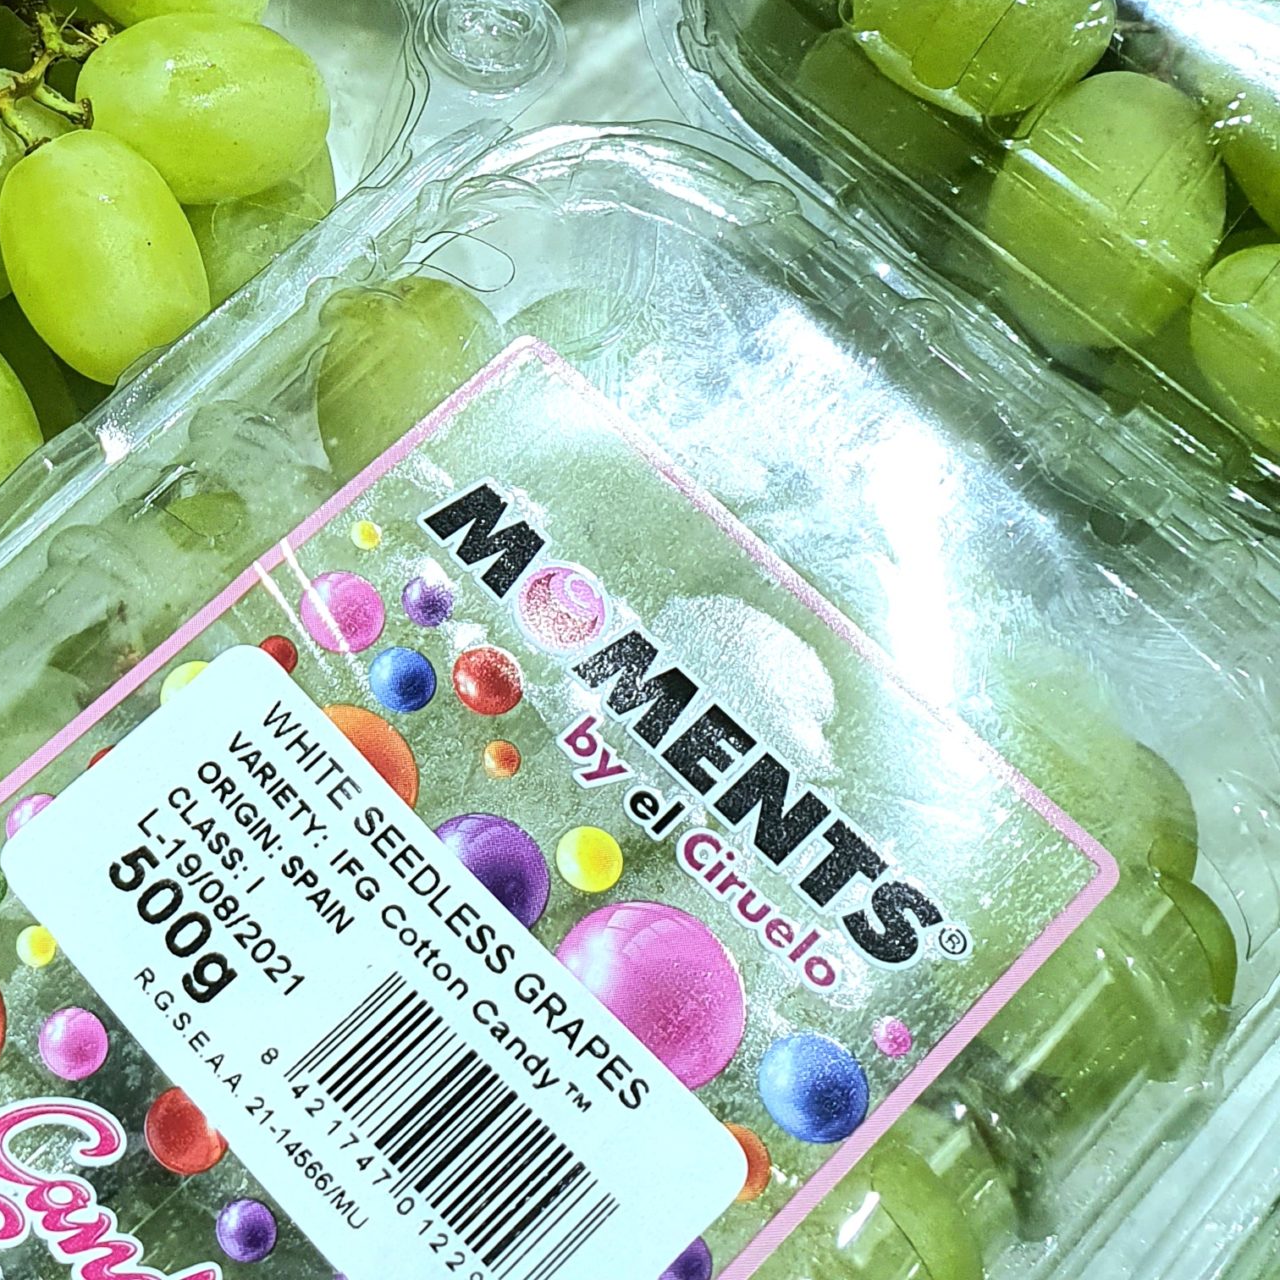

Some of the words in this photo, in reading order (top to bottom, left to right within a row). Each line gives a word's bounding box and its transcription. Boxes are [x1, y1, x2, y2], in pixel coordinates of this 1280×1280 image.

[137, 808, 305, 996] L-19/08/2021
[168, 787, 248, 879] CLASS:
[197, 761, 283, 859] ORIGIN:
[281, 855, 355, 934] SPAIN
[229, 730, 328, 848] VARIETY:
[330, 848, 380, 902] IFG
[381, 904, 469, 1000] Cotton
[263, 700, 362, 811] WHITE
[353, 806, 515, 974] SEEDLESS
[514, 973, 650, 1110] GRAPES
[563, 716, 630, 783] by
[630, 790, 686, 835] el
[683, 833, 836, 988] Ciruelo
[108, 845, 238, 1004] 500g
[245, 1096, 369, 1230] 21-14566/MU
